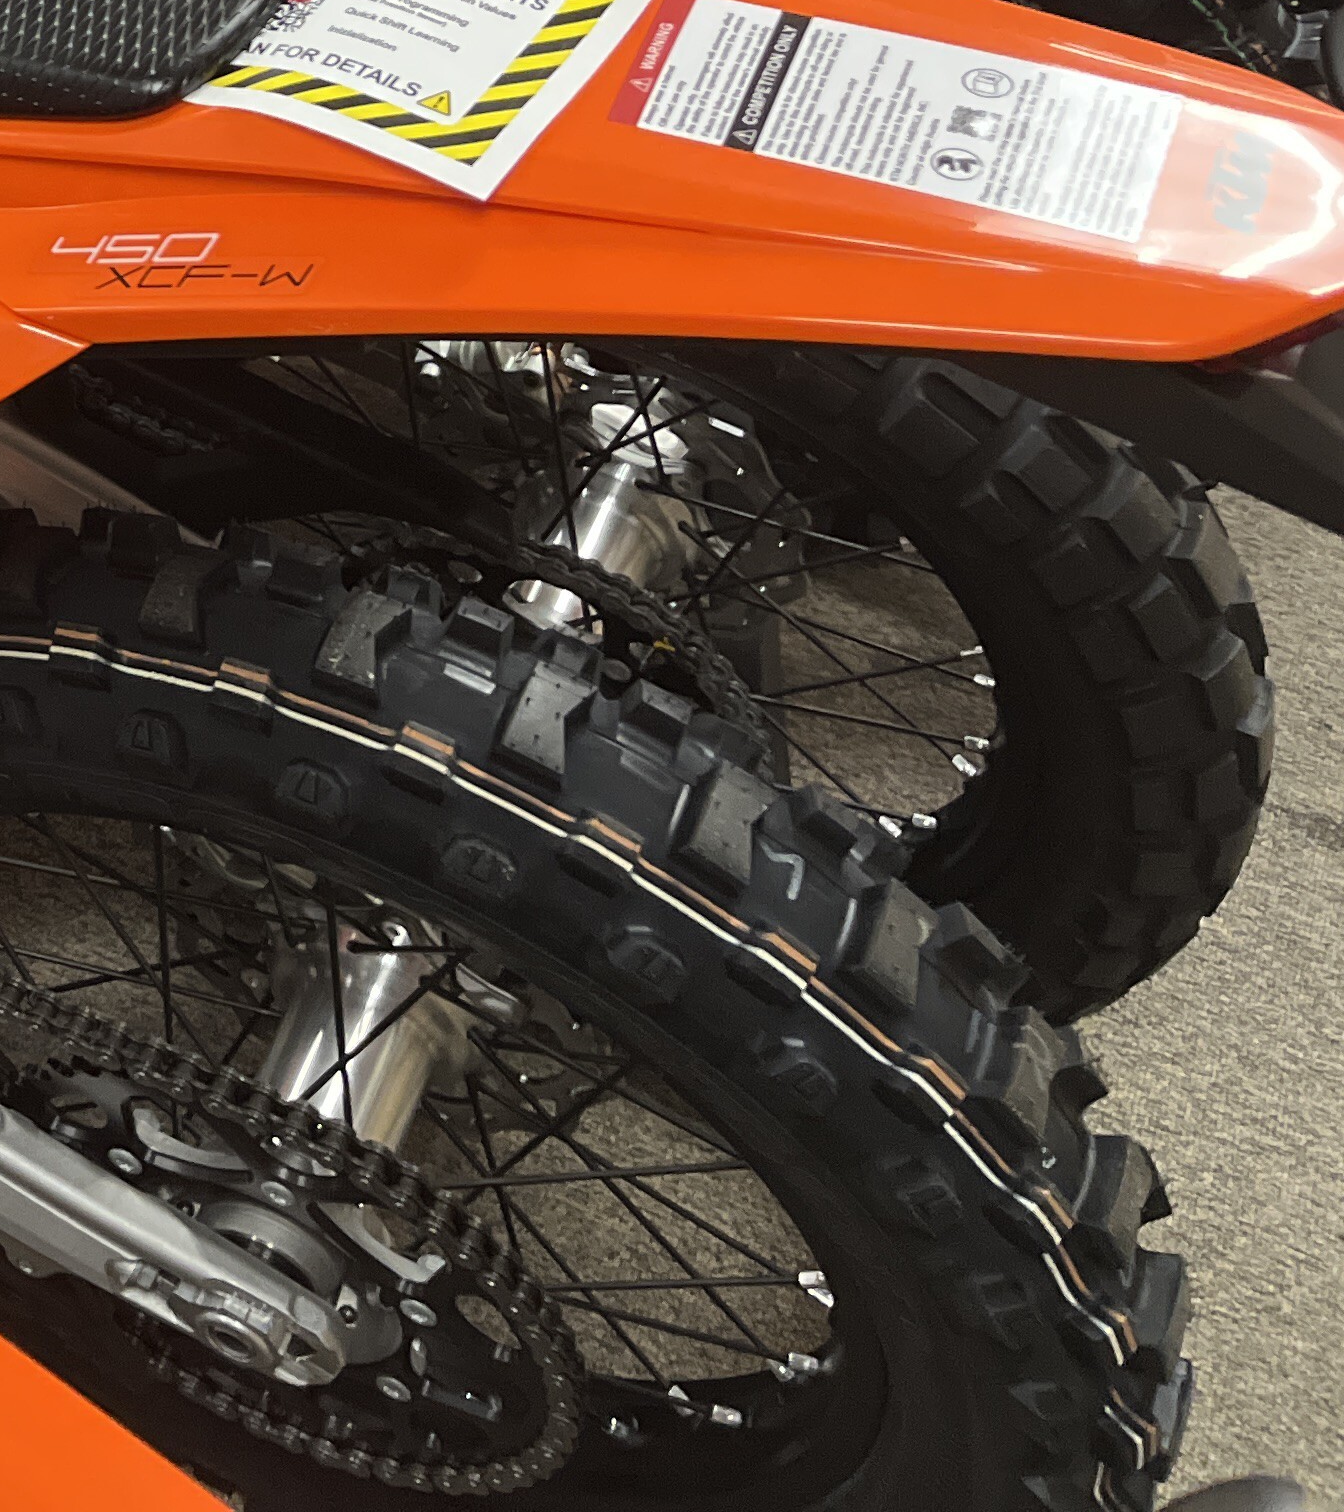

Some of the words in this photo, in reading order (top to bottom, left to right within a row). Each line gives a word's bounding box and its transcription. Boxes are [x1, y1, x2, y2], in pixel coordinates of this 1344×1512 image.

[344, 6, 379, 21] Quick
[379, 15, 408, 31] Shift
[640, 22, 674, 71] WARNING
[270, 43, 321, 62] FOR
[321, 52, 423, 98] DETAILS
[741, 54, 785, 126] COMPETITION
[774, 24, 799, 53] ONLY
[51, 232, 221, 264] 450
[95, 263, 314, 289] XCF-W
